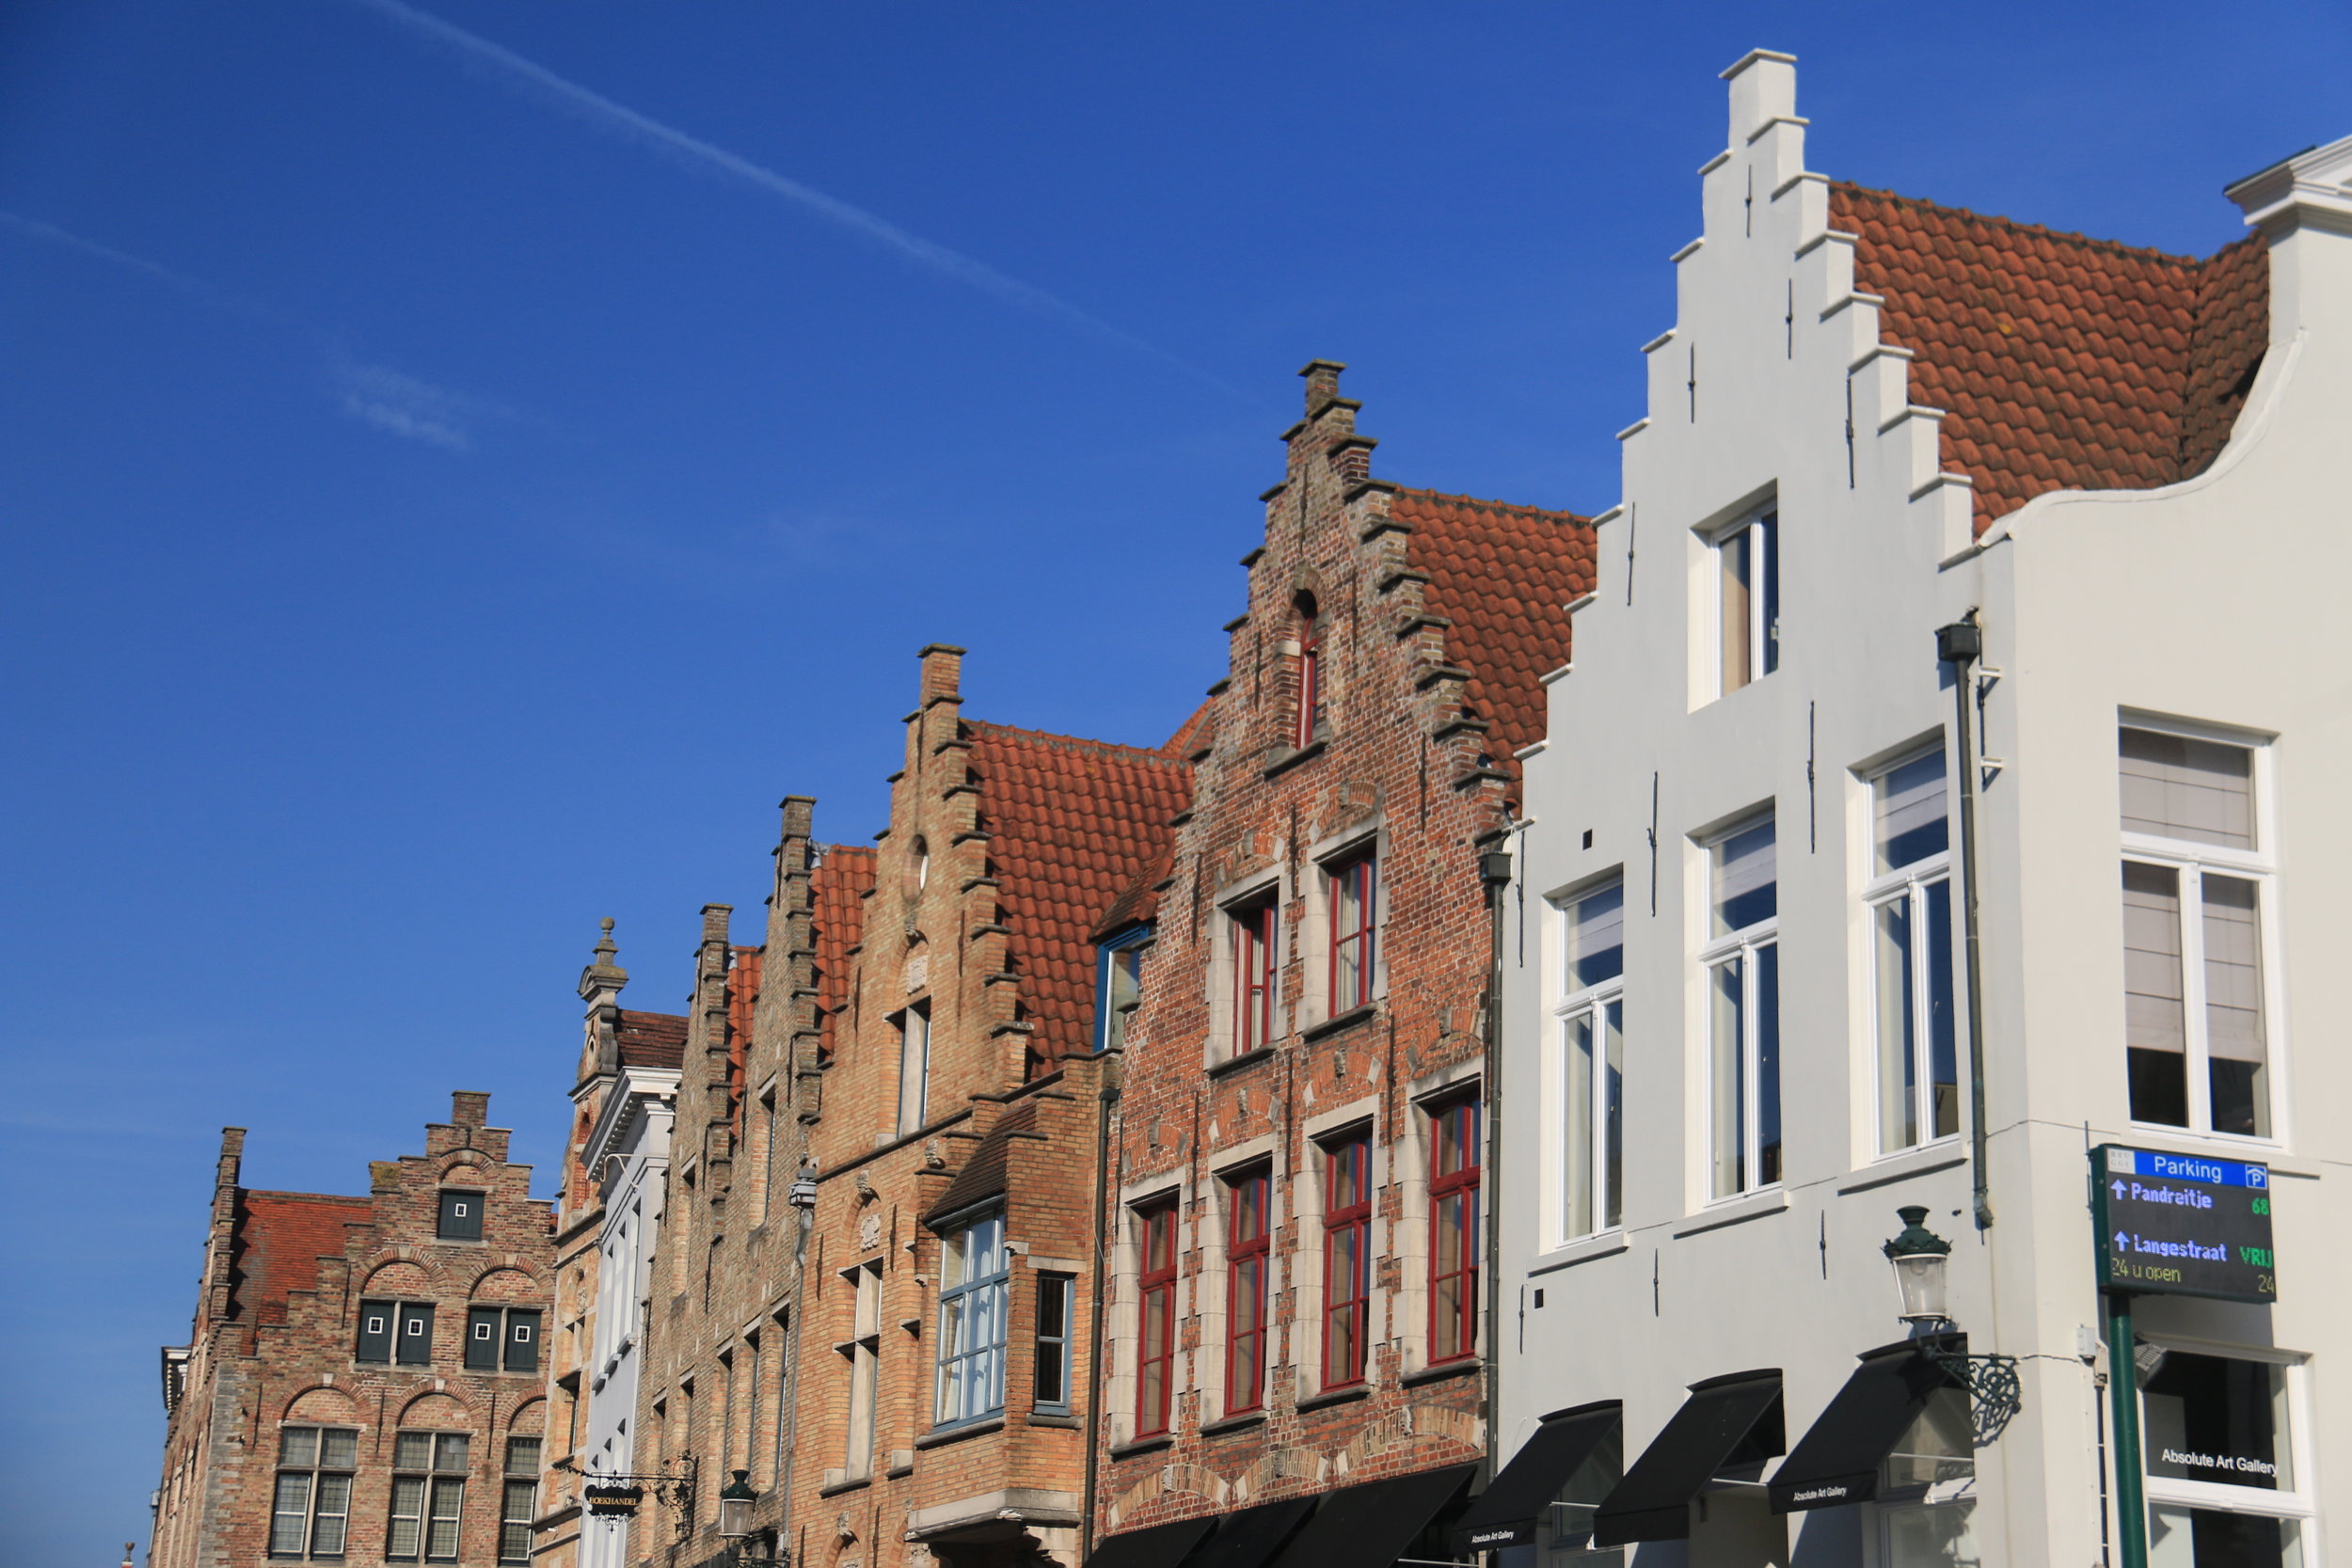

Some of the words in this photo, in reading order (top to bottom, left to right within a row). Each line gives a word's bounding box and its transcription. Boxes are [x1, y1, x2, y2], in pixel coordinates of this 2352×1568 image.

[2154, 1156, 2222, 1183] Parking
[2131, 1182, 2213, 1209] Pandreitje
[2251, 1197, 2269, 1215] 68
[2134, 1233, 2227, 1261] Langestraat
[2239, 1246, 2273, 1268] VRIJ
[2112, 1257, 2128, 1277] 24
[2133, 1265, 2142, 1278] u
[2145, 1266, 2182, 1283] open
[2258, 1275, 2274, 1293] 24
[2162, 1449, 2214, 1467] Absolute
[2216, 1455, 2233, 1470] Art
[2236, 1457, 2279, 1477] Gallery
[589, 1497, 637, 1505] BOEKHANDEL
[1793, 1491, 1818, 1501] Absolute
[1818, 1488, 1826, 1497] Art
[1826, 1486, 1847, 1497] Gallery
[1471, 1533, 1491, 1544] Absolute
[1498, 1530, 1514, 1540] Gallery
